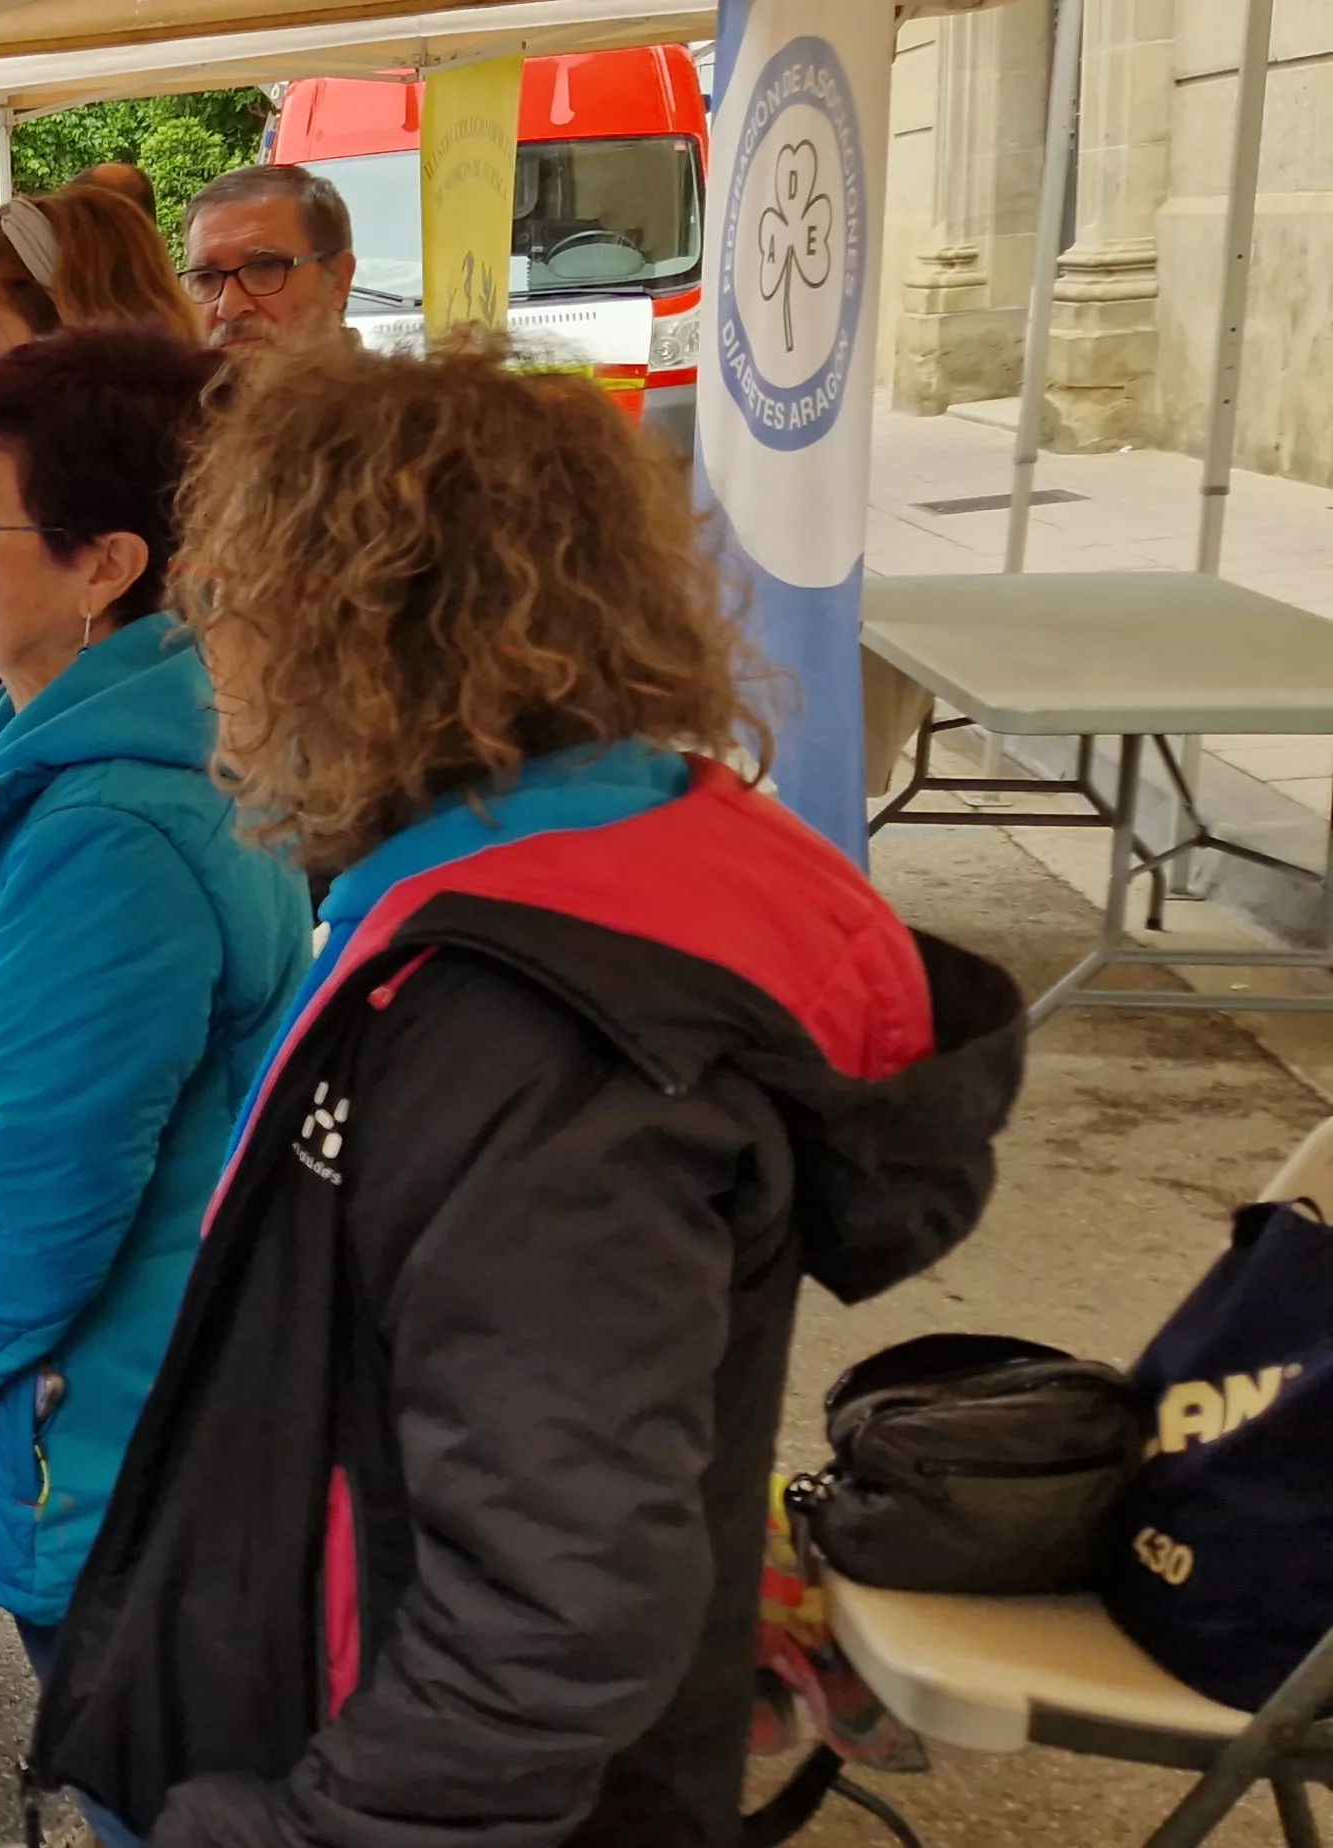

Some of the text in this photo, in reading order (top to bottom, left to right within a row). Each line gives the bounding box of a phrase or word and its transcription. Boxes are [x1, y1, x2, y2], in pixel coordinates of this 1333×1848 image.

[788, 170, 798, 200] D
[767, 234, 775, 263] A
[805, 225, 817, 255] E
[722, 319, 784, 430] DIABETES
